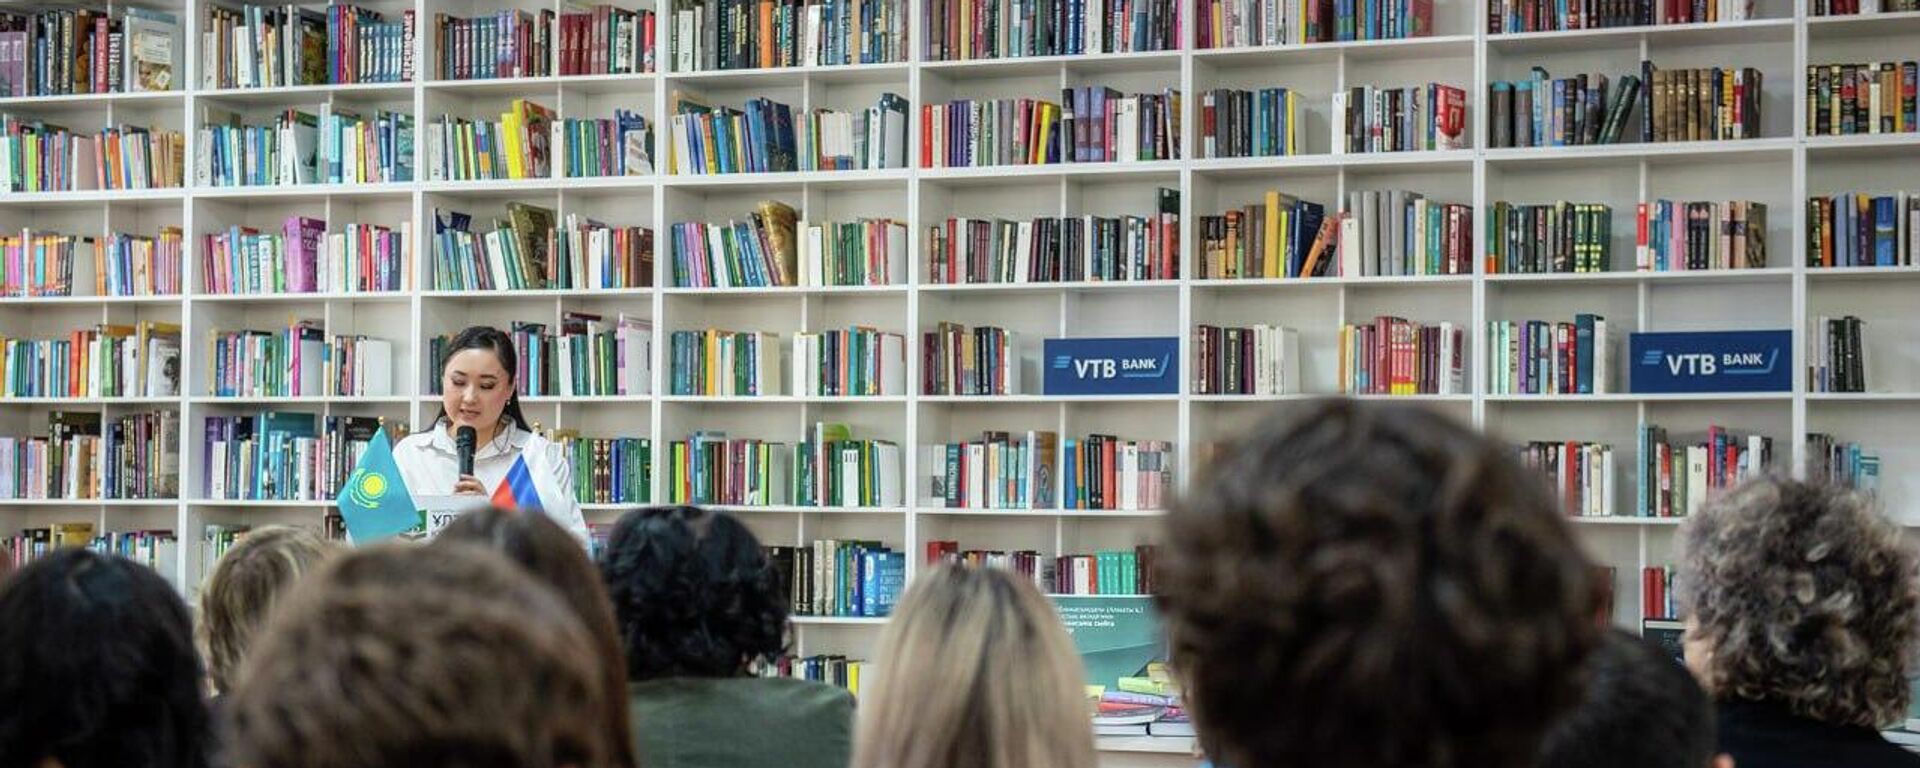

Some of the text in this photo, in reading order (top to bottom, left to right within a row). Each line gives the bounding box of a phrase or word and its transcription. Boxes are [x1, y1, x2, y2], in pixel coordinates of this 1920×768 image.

[1074, 358, 1156, 379] VTB BANK
[1666, 353, 1763, 375] VTB BANK
